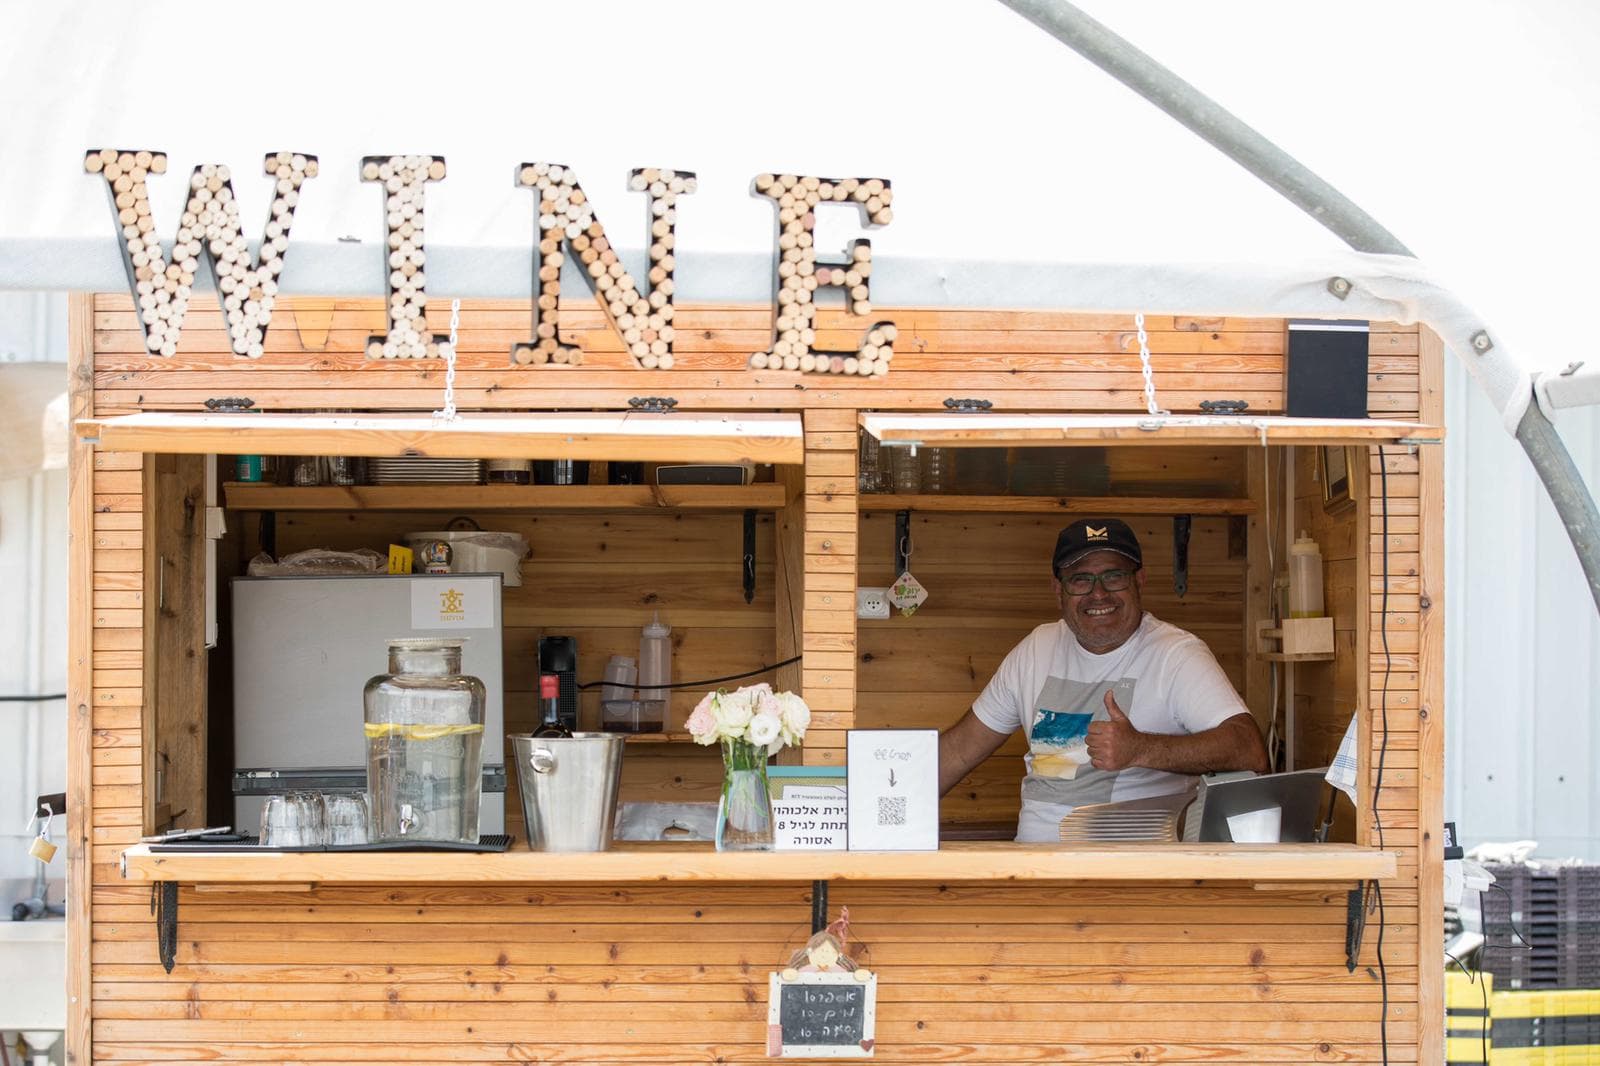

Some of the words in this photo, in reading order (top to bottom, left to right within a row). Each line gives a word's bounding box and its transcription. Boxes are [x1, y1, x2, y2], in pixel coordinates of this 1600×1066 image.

[84, 149, 896, 377] WINE
[777, 821, 786, 830] 8
[790, 820, 816, 830] לגיל
[820, 821, 847, 830] תחת
[793, 836, 832, 845] אסורה
